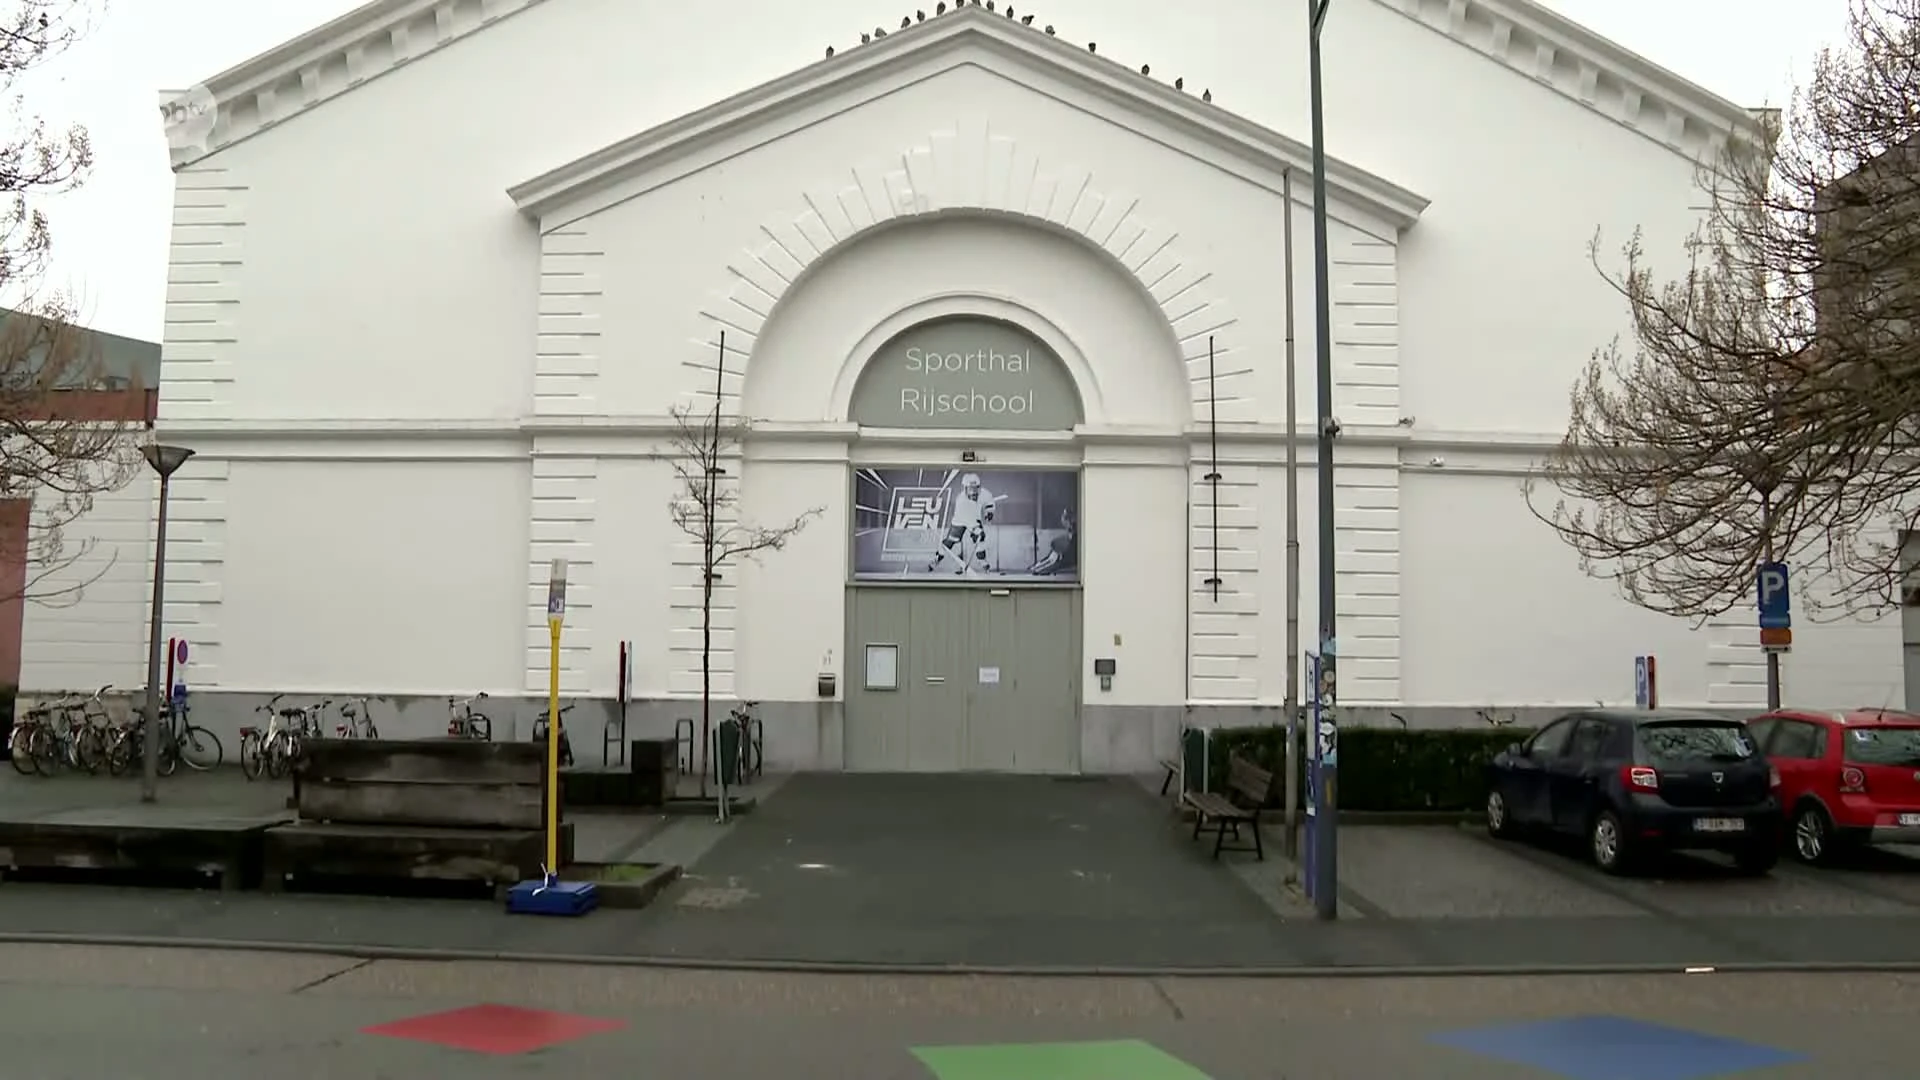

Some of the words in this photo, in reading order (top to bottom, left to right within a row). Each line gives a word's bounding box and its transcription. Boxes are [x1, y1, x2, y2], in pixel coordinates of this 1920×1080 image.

[905, 347, 1030, 376] Sporthal
[901, 386, 1033, 417] Rijschool
[897, 496, 943, 514] LEU
[894, 513, 940, 530] VEN
[1761, 570, 1785, 605] P
[1636, 663, 1645, 697] P
